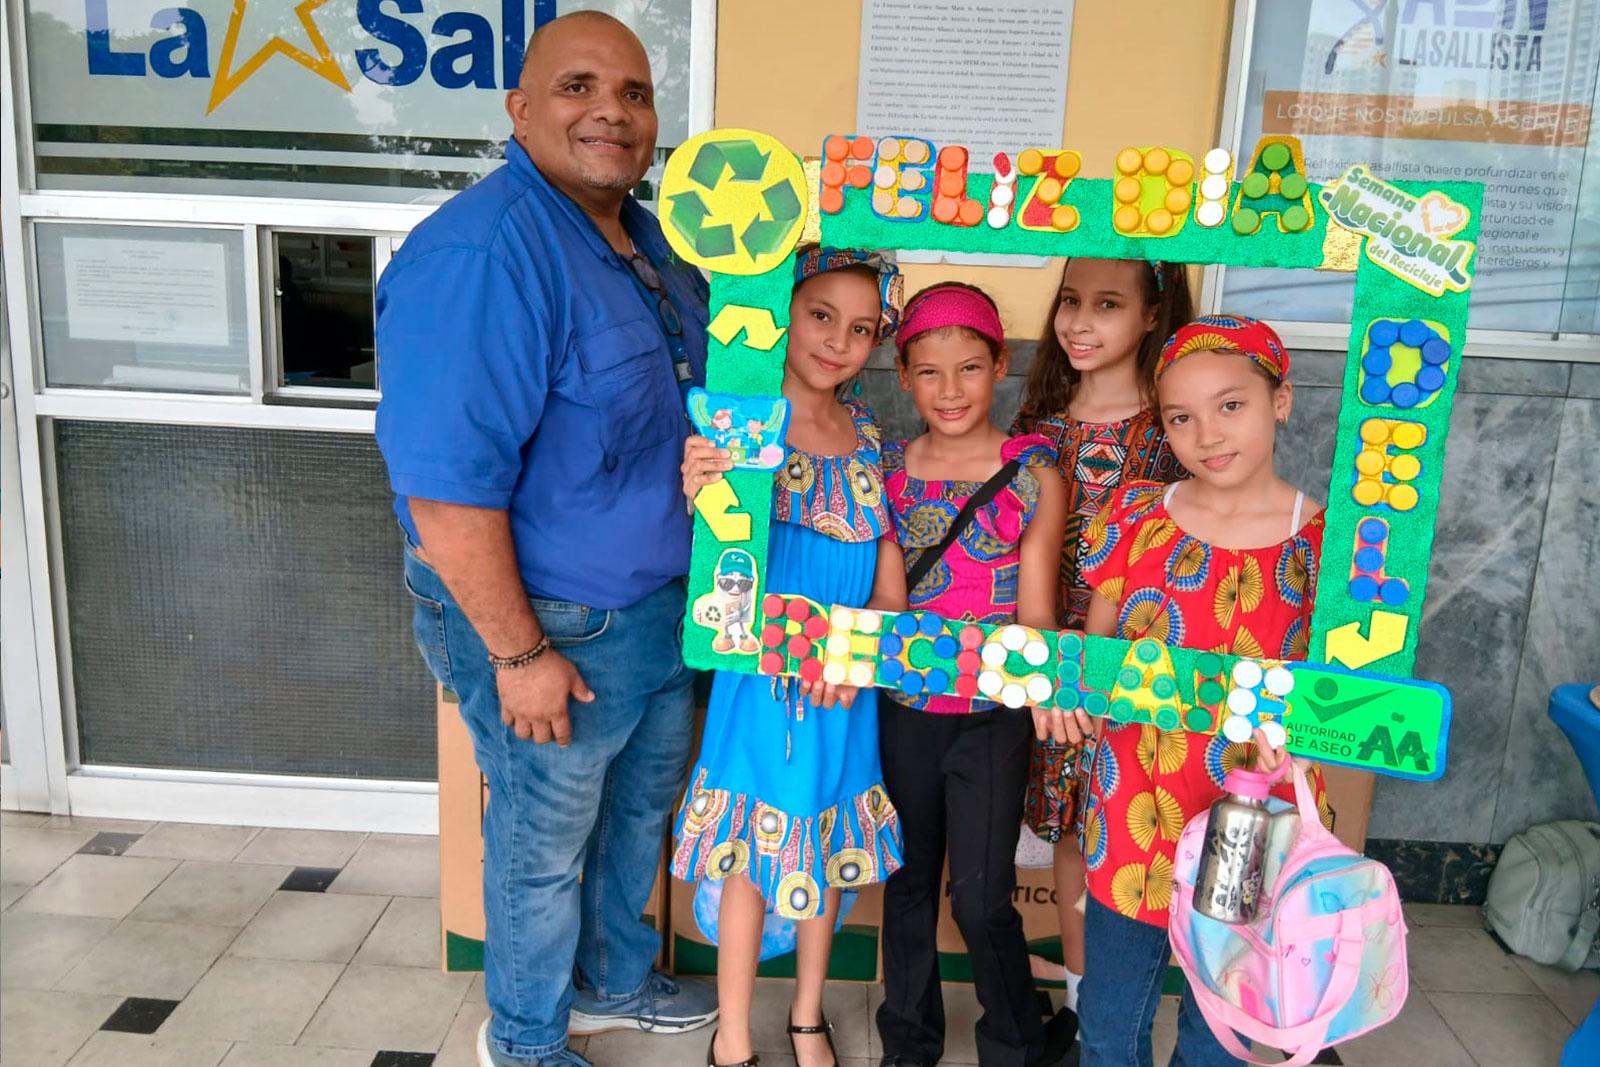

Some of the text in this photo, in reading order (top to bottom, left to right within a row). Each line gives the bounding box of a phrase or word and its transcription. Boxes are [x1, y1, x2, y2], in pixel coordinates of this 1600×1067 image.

[85, 0, 557, 90] La Sal
[1398, 27, 1543, 72] LASALLISTA
[1276, 103, 1303, 120] LO
[1356, 107, 1396, 124] NOS
[1113, 134, 1315, 238] DIA
[1347, 167, 1417, 213] Semana
[1364, 160, 1420, 175] asallista
[1424, 164, 1461, 177] quiere
[1465, 166, 1536, 181] profundizar
[1541, 171, 1556, 180] en
[1543, 186, 1567, 198] que
[1328, 184, 1466, 272] Nacional
[1519, 201, 1533, 211] su
[1539, 215, 1554, 227] de
[1369, 244, 1443, 289] del Reciclaje
[1350, 317, 1451, 607] DEL
[758, 593, 1296, 750] RECICLAJE
[1286, 721, 1356, 743] AUTORIDAD
[1308, 737, 1353, 758] ASEO
